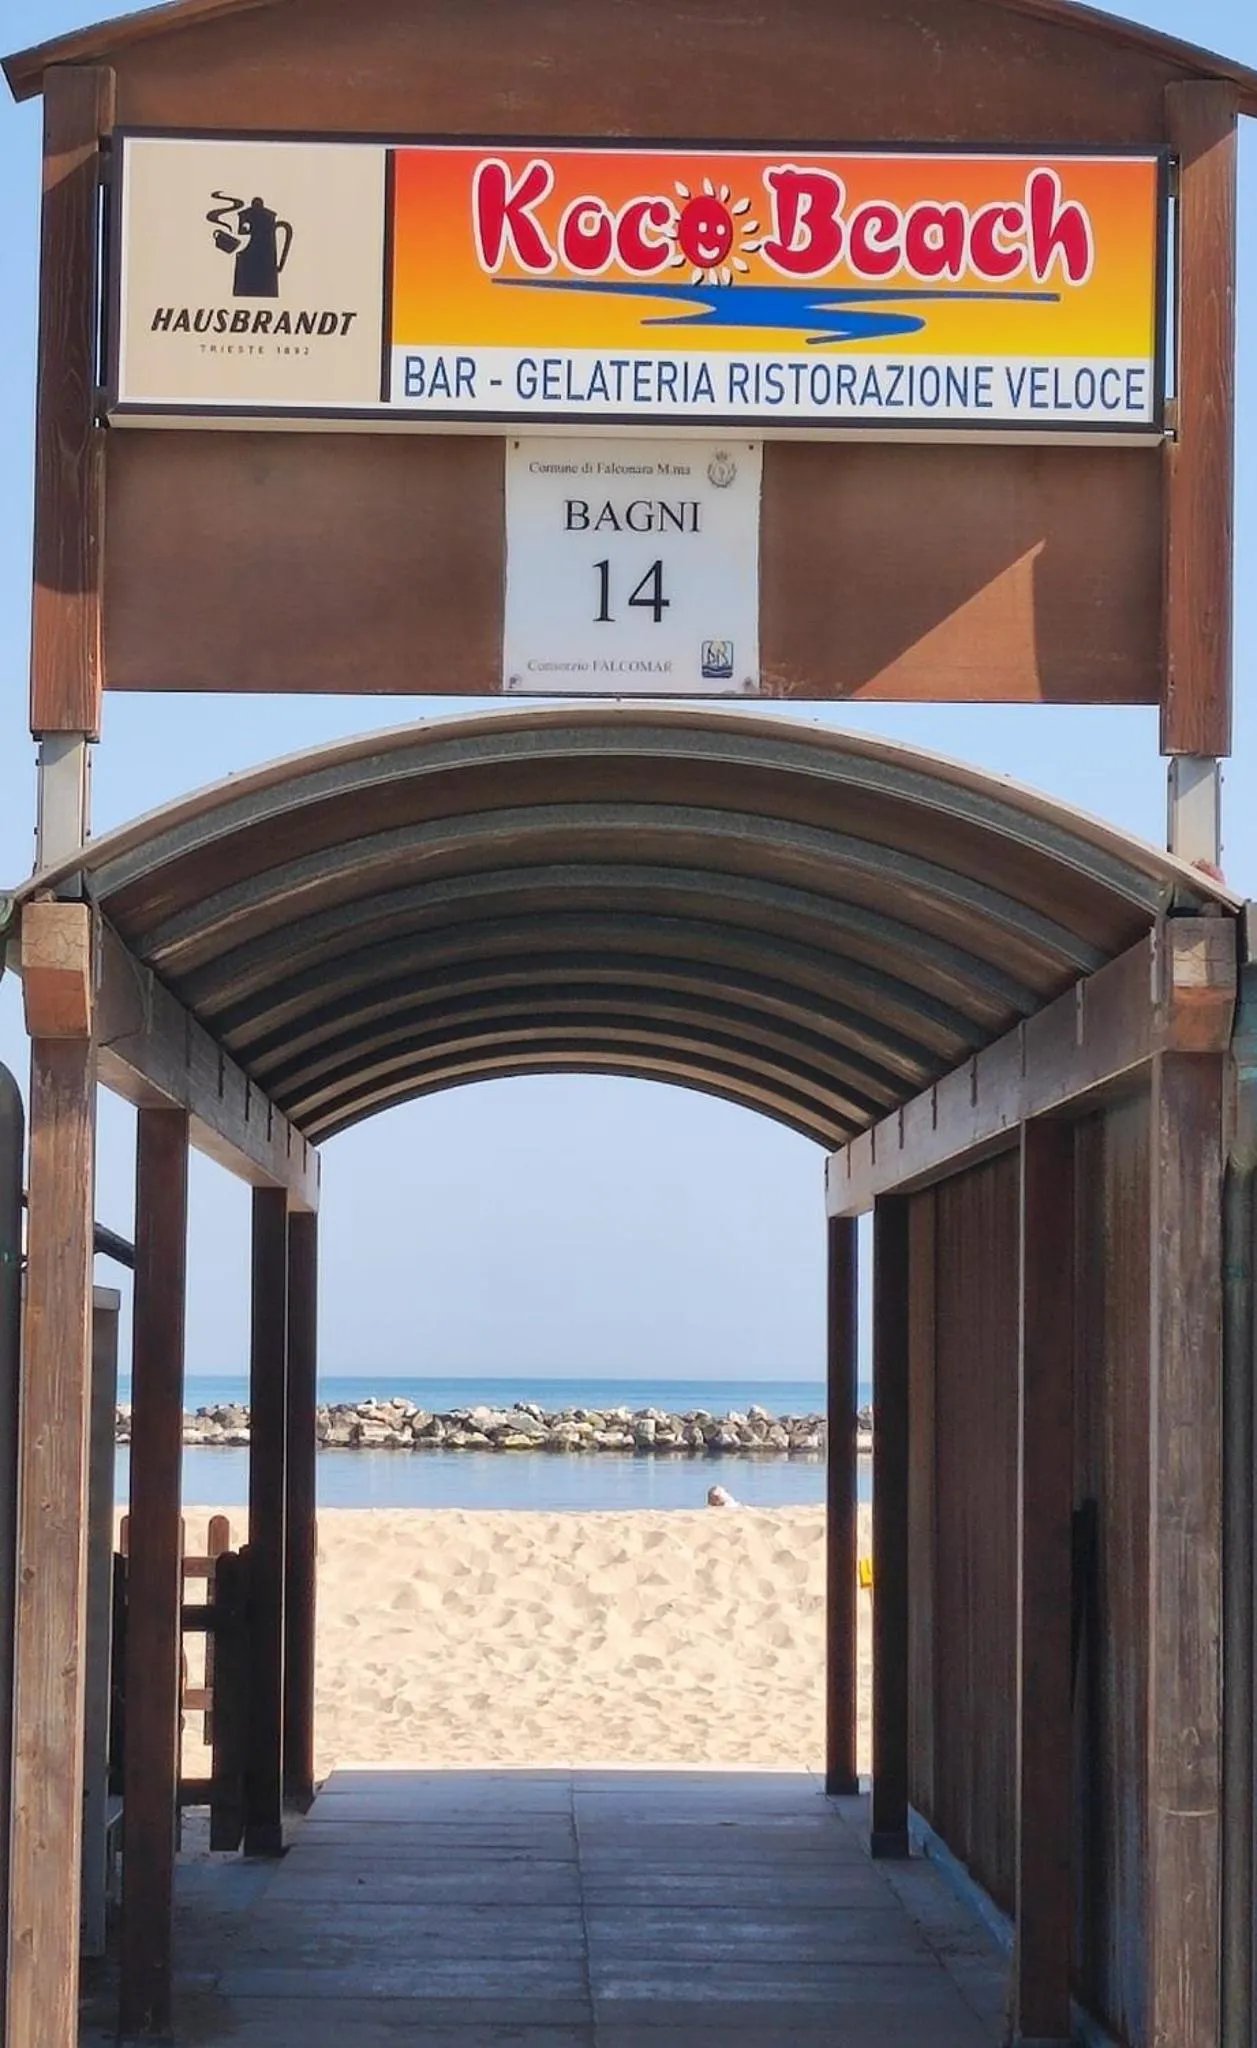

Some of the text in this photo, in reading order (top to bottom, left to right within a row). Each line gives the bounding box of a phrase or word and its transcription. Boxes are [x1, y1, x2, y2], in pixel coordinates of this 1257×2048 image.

[763, 164, 1094, 286] Beach
[151, 307, 357, 336] HAUSBRANDT
[200, 343, 264, 355] TRIESTE
[404, 356, 476, 398] BAR
[516, 358, 715, 402] GELATERIA
[728, 362, 993, 408] RISTORAZIONE
[1005, 366, 1145, 410] VELOCE
[529, 461, 578, 474] Comune
[582, 461, 593, 474] di
[597, 461, 653, 475] Falconara
[565, 500, 701, 532] BAGNI
[592, 559, 671, 623] 14
[527, 660, 672, 673] Consorzio FALCOMAR
